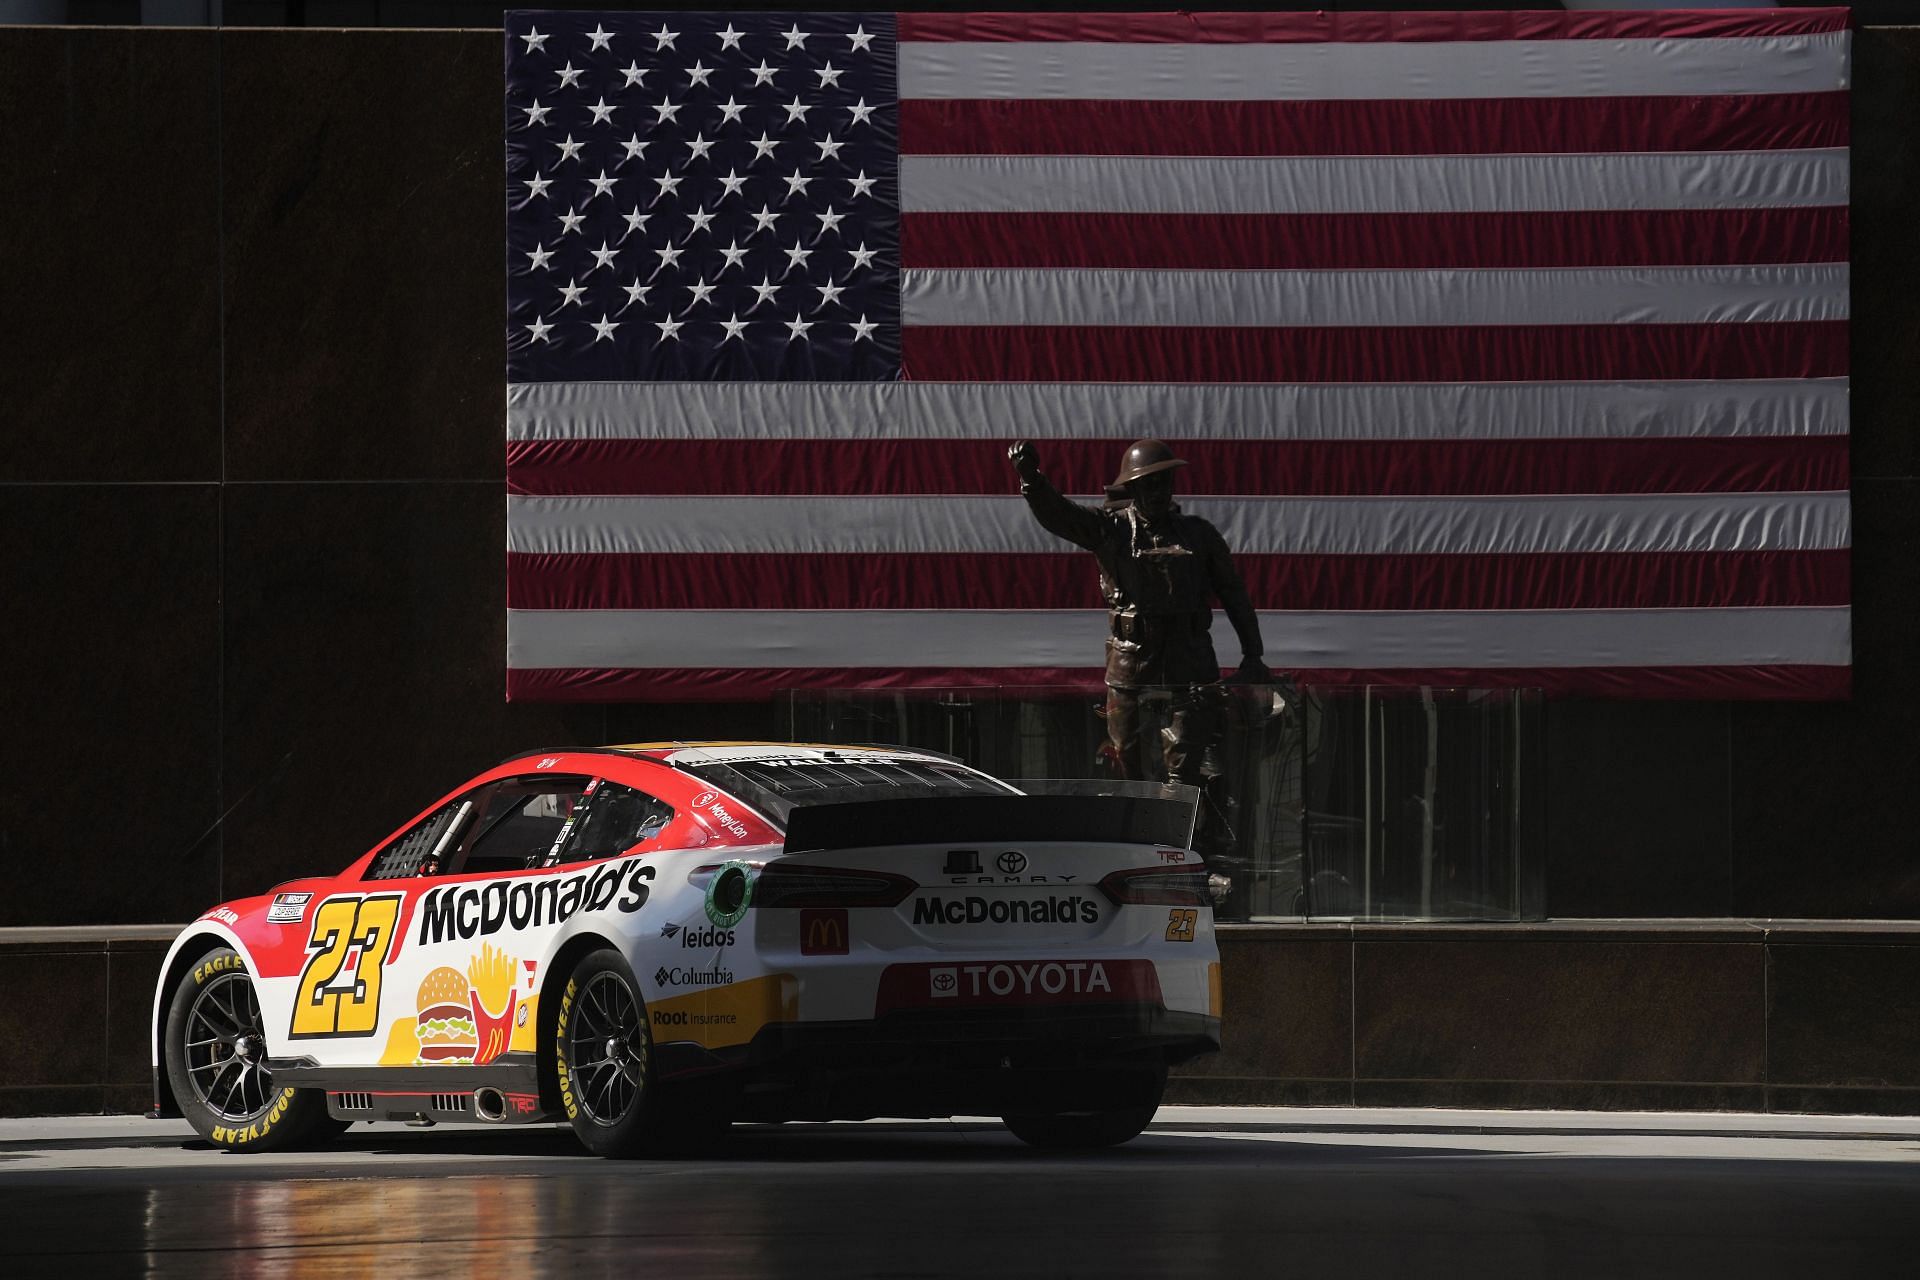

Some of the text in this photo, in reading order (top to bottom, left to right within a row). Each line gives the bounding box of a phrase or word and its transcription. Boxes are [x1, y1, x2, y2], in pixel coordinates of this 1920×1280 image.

[757, 757, 899, 768] WALLACE
[708, 803, 748, 839] MoneyLion
[1157, 851, 1185, 863] TRD
[951, 875, 1077, 884] CAMRY
[418, 858, 657, 946] McDonald's
[912, 896, 1099, 925] McDonald's
[681, 925, 735, 949] leidos
[1165, 909, 1198, 942] 23
[194, 954, 243, 985] EAGLE
[288, 894, 403, 1041] 23
[669, 966, 733, 986] Columbia
[964, 962, 1112, 997] TOYOTA
[653, 1010, 737, 1025] Root Insurance
[556, 977, 578, 1119] GOODYEAR
[212, 1087, 295, 1144] OODYEAR
[508, 1098, 536, 1115] TRD
